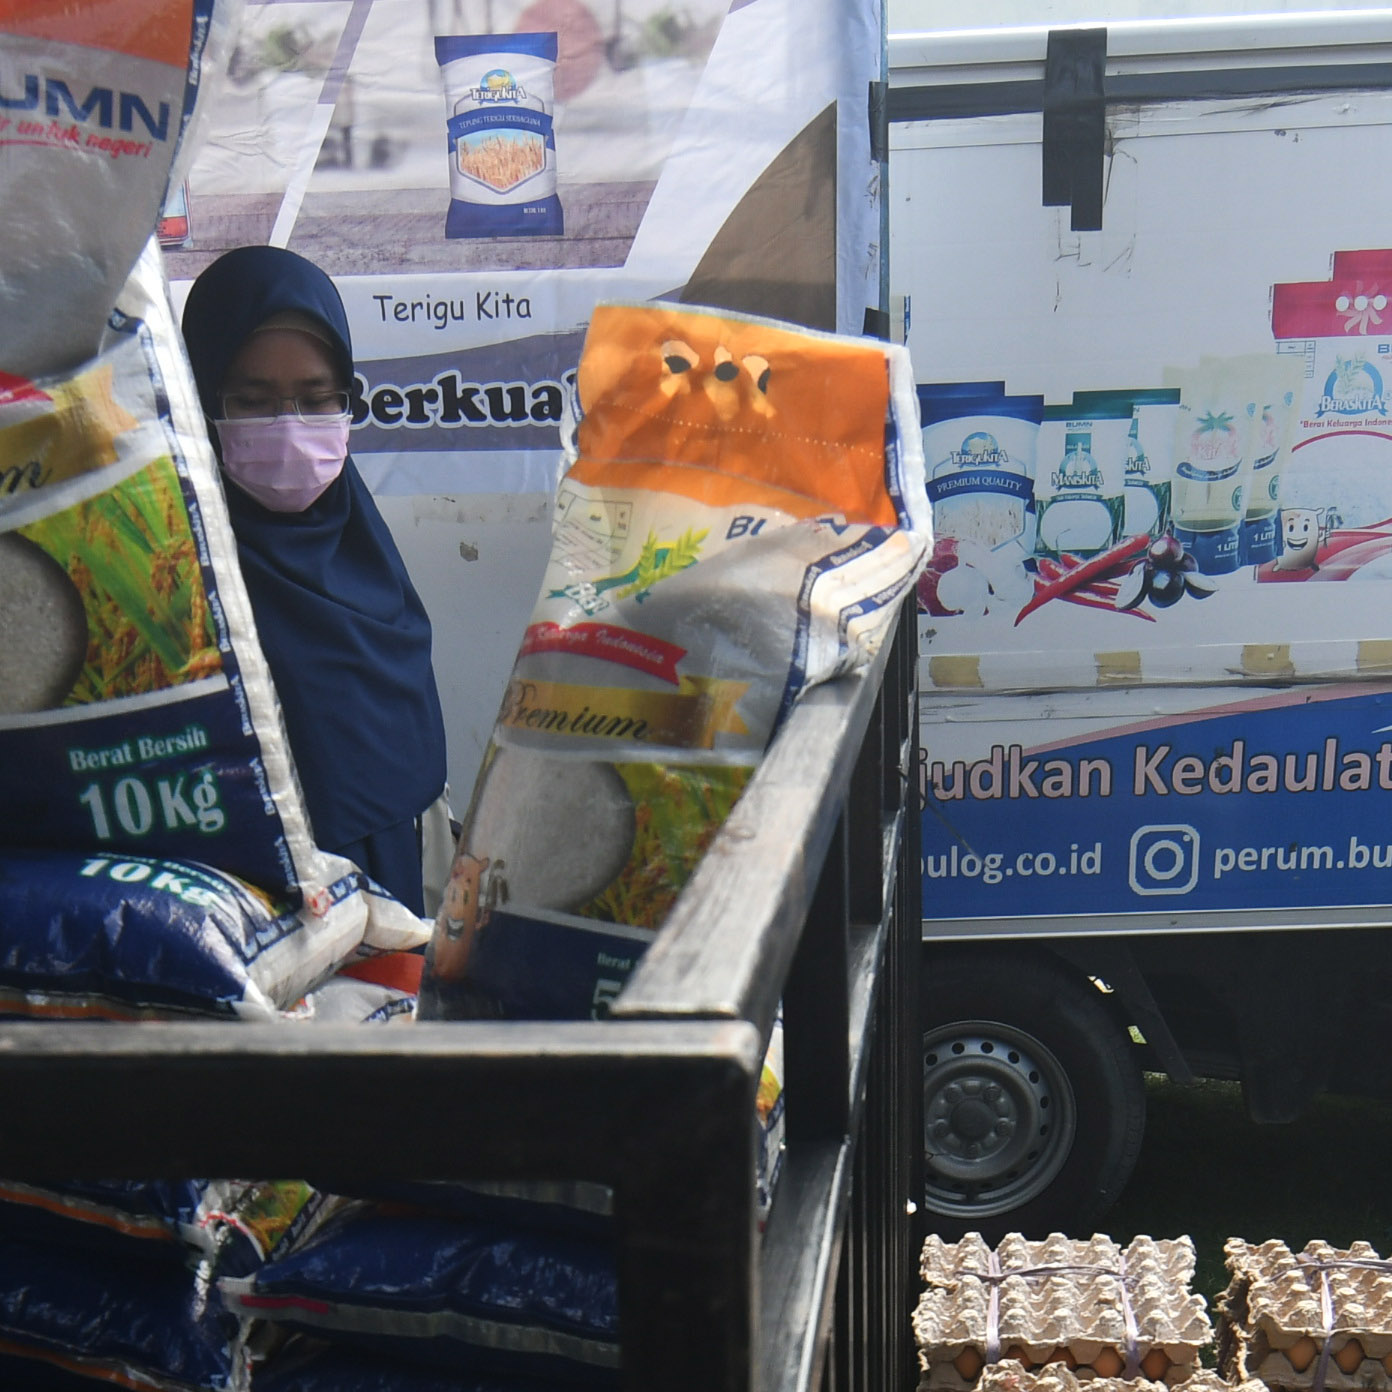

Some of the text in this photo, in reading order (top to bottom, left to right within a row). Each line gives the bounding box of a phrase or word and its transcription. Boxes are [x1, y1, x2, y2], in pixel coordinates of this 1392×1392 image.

[17, 118, 80, 143] untuk
[86, 131, 153, 159] negeri
[373, 291, 532, 330] Terigu Kita
[1327, 418, 1364, 429] Keluarga
[936, 476, 1022, 493] PREMIUM QUALITY
[502, 681, 651, 741] Premium
[68, 726, 208, 772] Berat Bersih
[920, 841, 1103, 884] ulog.co.id
